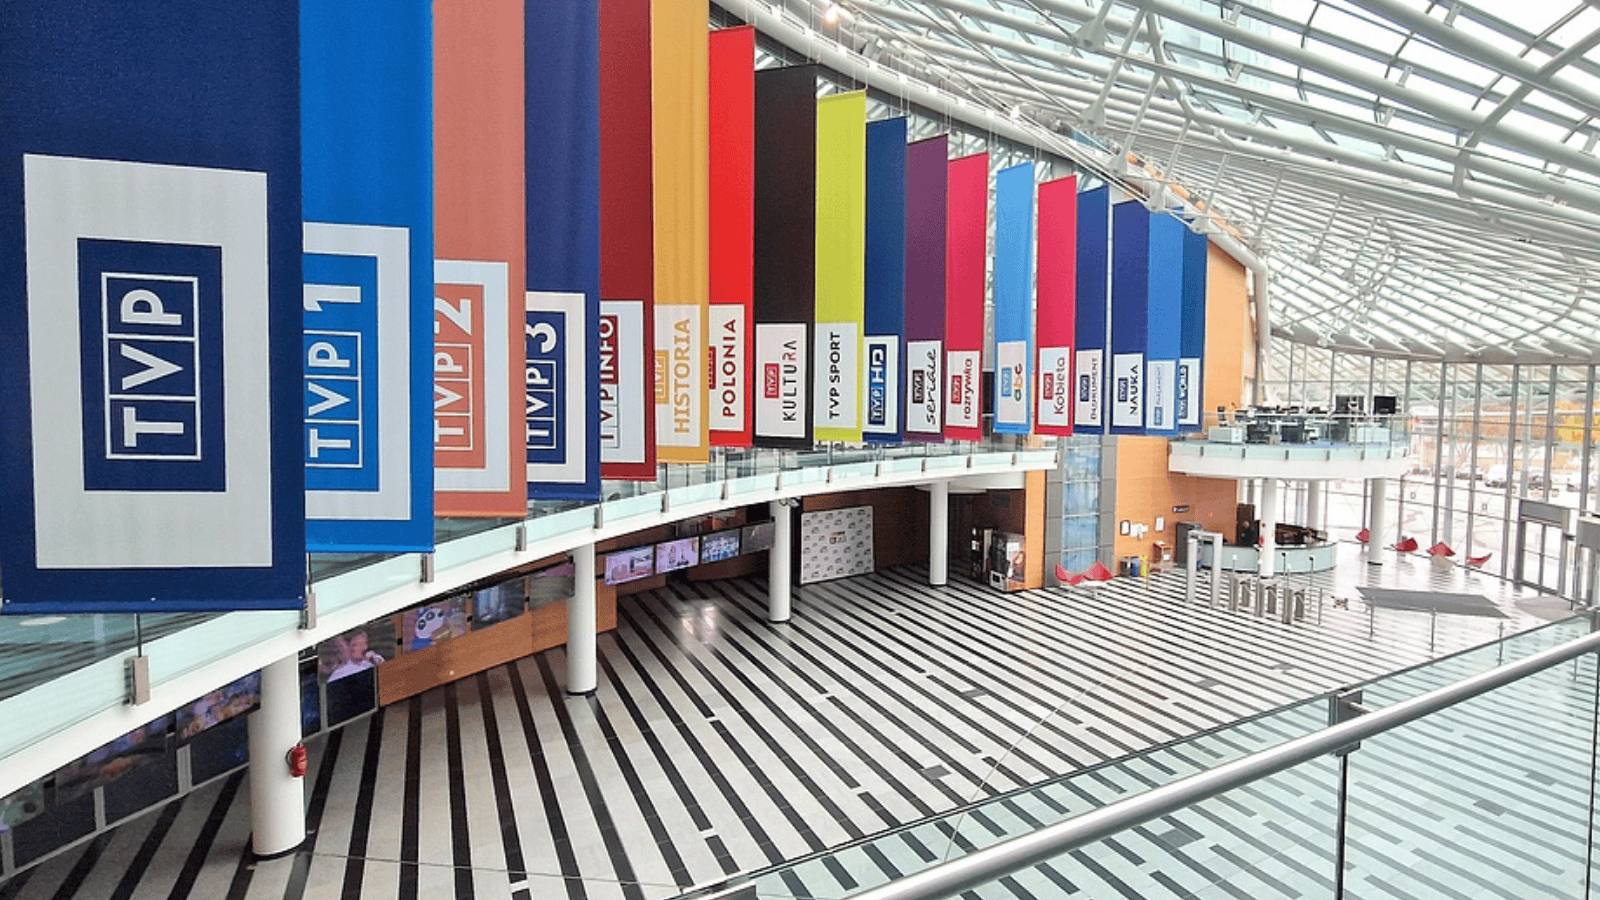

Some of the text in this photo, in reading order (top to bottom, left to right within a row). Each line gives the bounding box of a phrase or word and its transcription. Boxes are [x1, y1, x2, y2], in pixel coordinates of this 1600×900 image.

[120, 288, 184, 448] TVP
[303, 285, 362, 458] TVP 1
[434, 298, 472, 442] TVP 2
[526, 322, 557, 442] TVP 3
[600, 318, 614, 382] INFO
[674, 319, 691, 434] HISTORIA
[722, 319, 737, 418] POLONIA
[782, 340, 798, 422] KULTURA
[829, 332, 841, 419] TVP SPORT
[871, 348, 885, 420] TVP HD
[926, 349, 937, 425] seriale
[963, 358, 974, 420] rozrywka
[1014, 363, 1024, 402] abc
[1053, 357, 1066, 415] Kobieta
[1129, 364, 1139, 416] NAUKA
